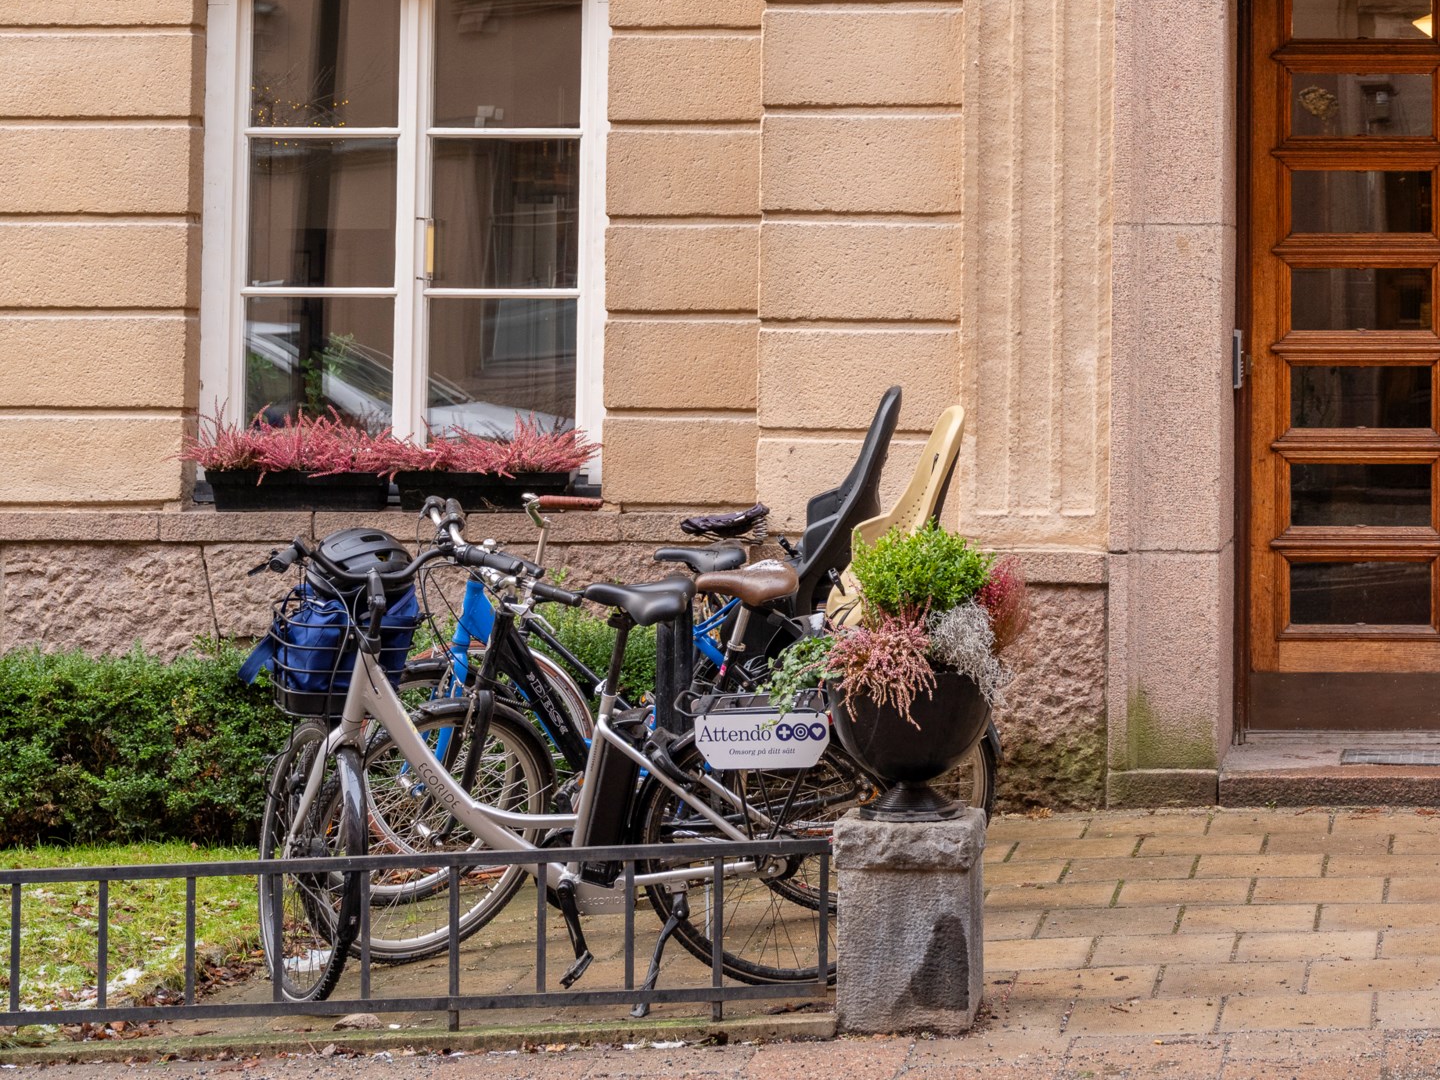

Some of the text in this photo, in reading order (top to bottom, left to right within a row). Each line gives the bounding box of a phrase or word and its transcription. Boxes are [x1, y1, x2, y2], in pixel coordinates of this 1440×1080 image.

[530, 678, 564, 727] DBS
[698, 724, 772, 743] Attendo
[728, 747, 757, 756] Omsorg
[757, 748, 767, 756] på
[767, 747, 781, 755] ditt
[418, 762, 461, 810] ECORIDE
